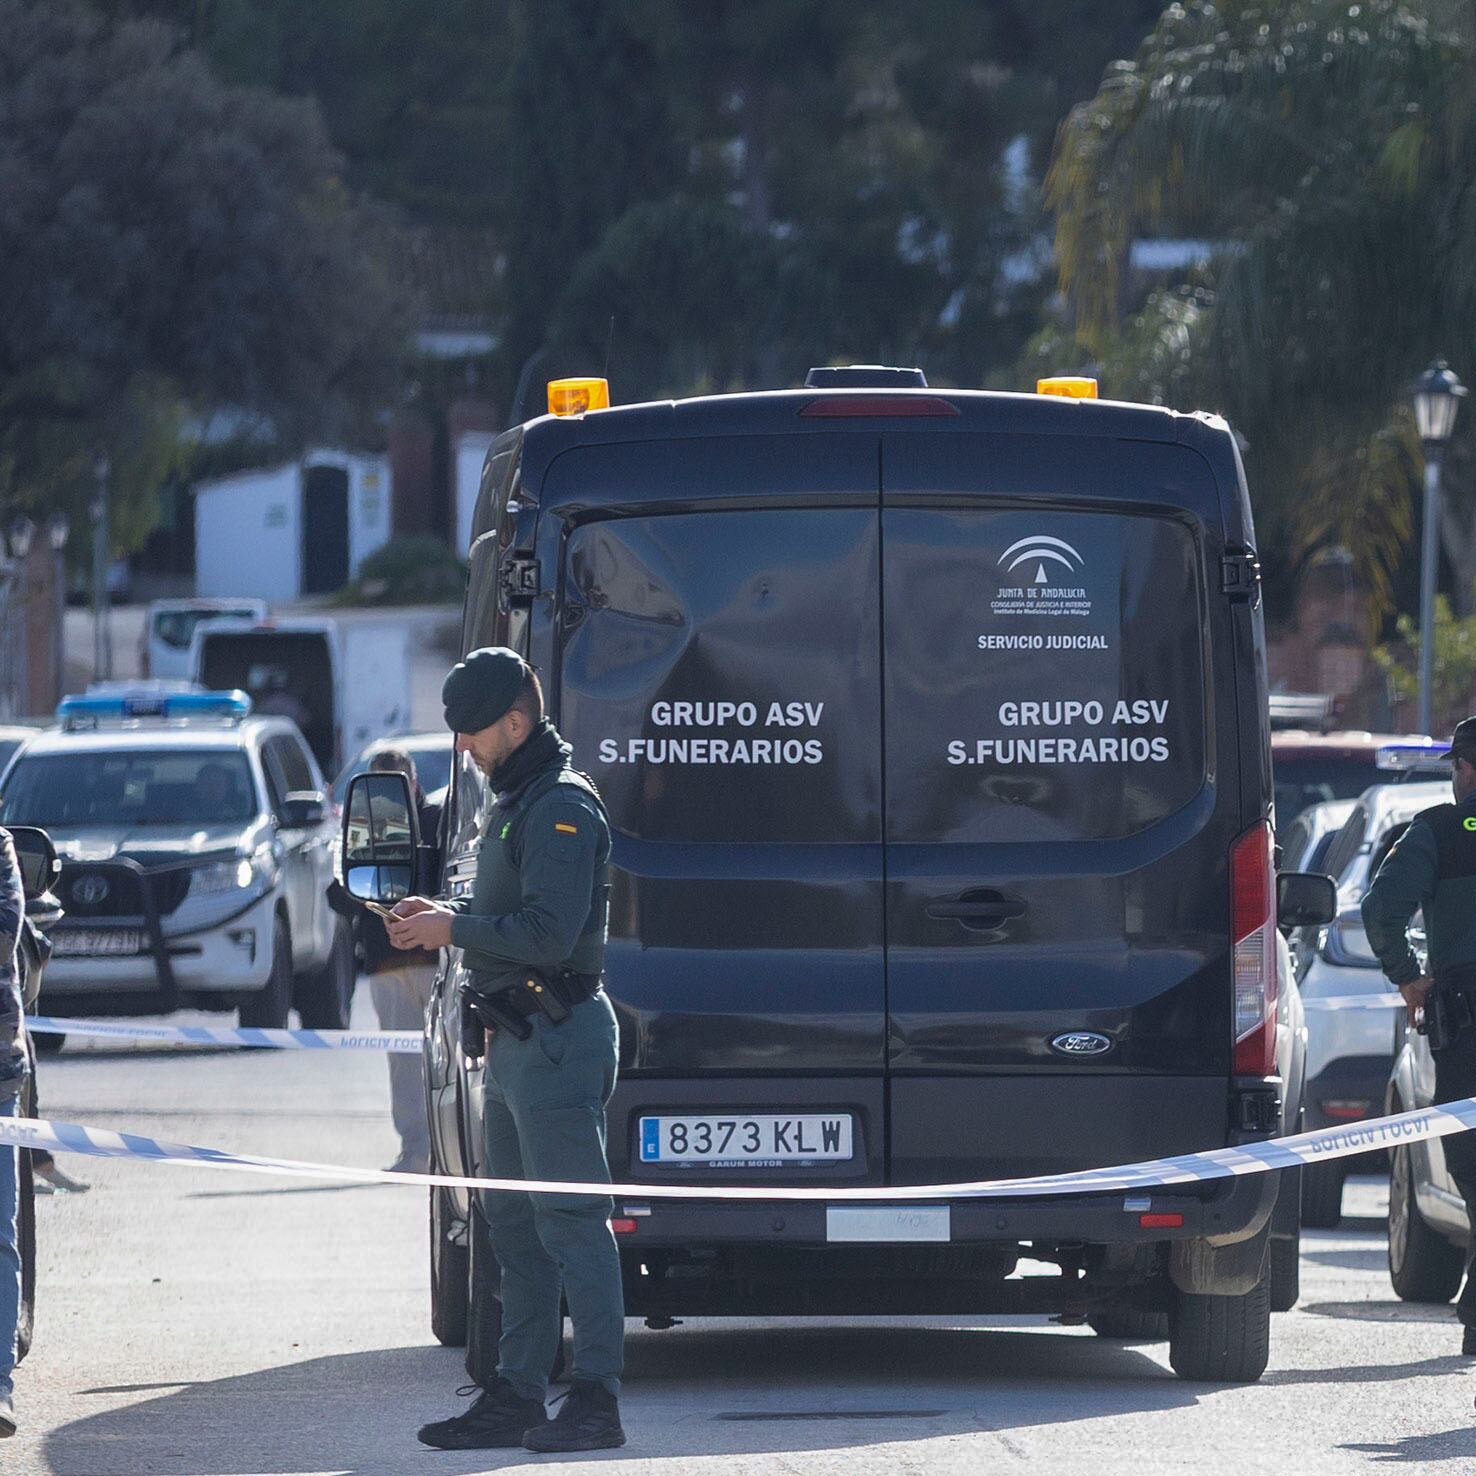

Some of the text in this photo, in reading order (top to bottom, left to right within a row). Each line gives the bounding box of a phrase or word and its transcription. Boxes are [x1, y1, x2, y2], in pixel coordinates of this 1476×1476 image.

[997, 588, 1024, 598] JUNTA
[1027, 588, 1038, 598] DE
[978, 635, 1108, 649] SERVICIO JUDICIAL
[651, 701, 824, 727] GRUPO ASV
[998, 700, 1169, 727] GRUPO ASV
[598, 738, 823, 765] S.FUNERARIOS
[947, 737, 1169, 765] S.FUNERARIOS
[647, 1144, 656, 1153] E
[669, 1120, 841, 1155] 8373 KLW
[747, 1160, 783, 1168] MOTOR
